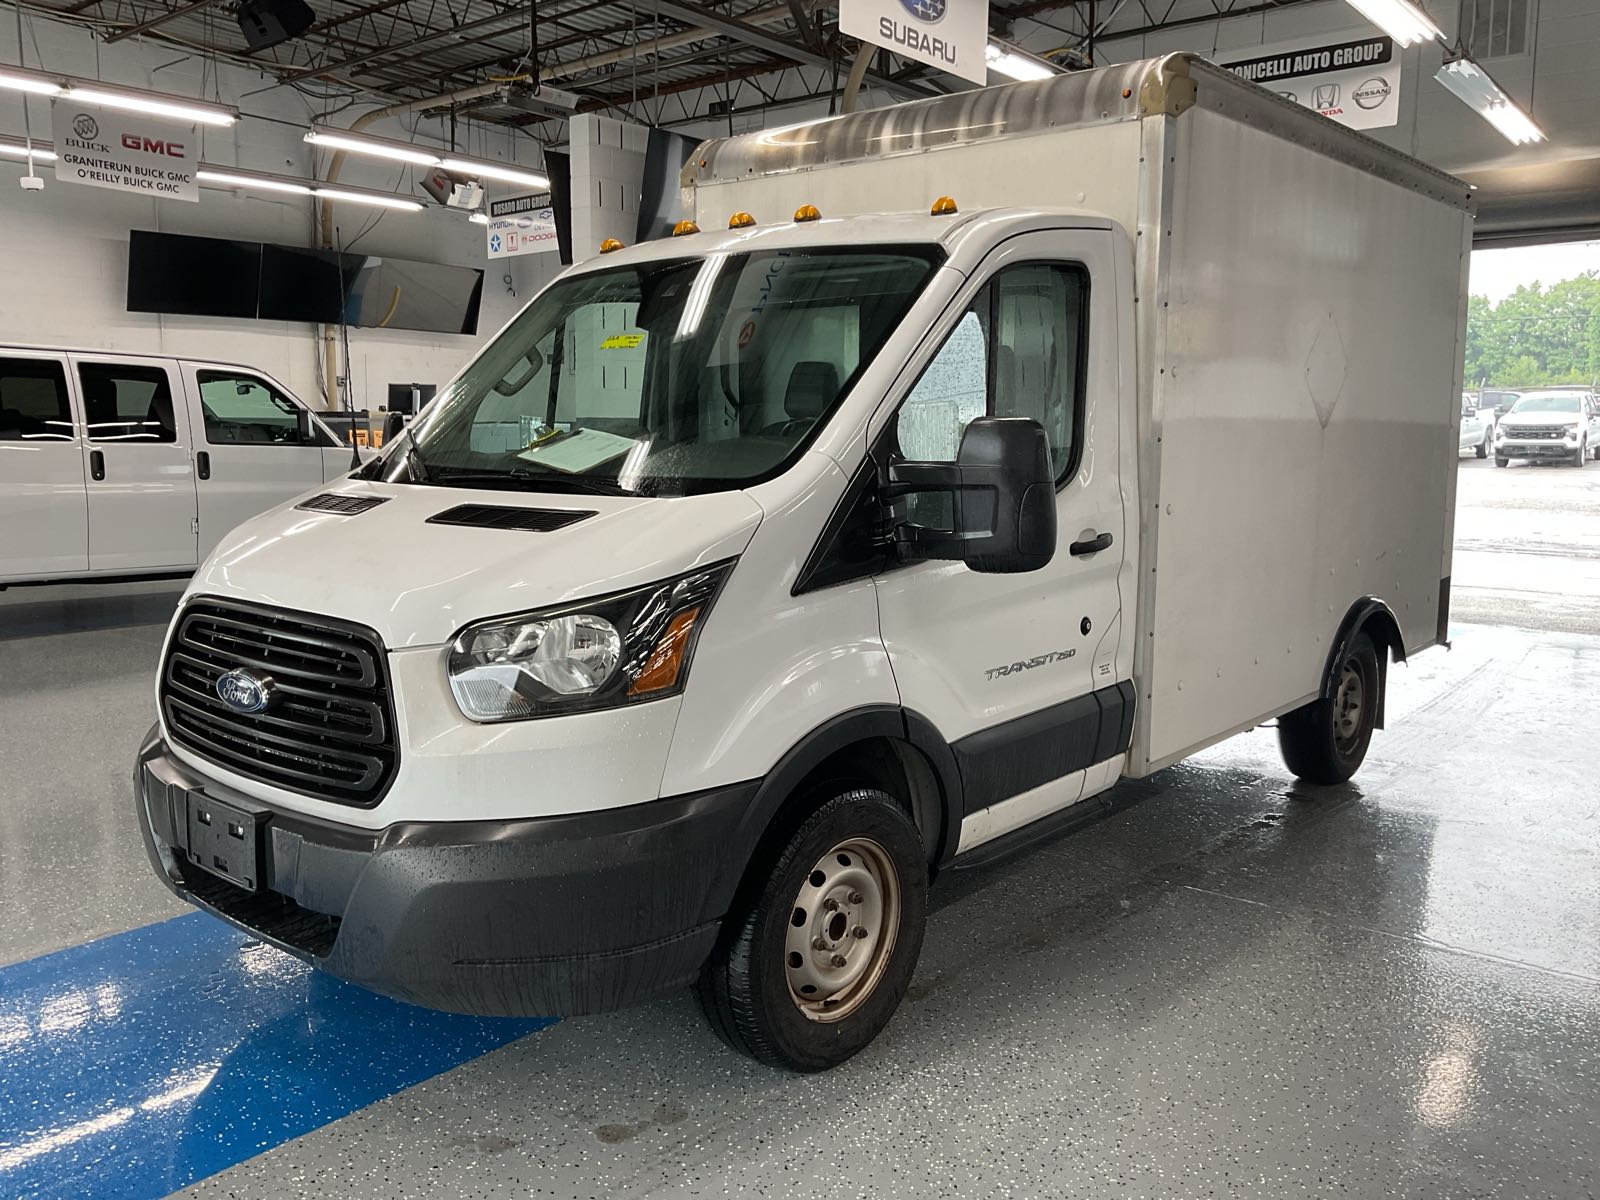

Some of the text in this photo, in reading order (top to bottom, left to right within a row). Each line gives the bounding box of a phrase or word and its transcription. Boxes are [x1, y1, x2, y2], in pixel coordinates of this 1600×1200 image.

[879, 17, 956, 64] SUBARU
[1293, 51, 1331, 72] AUTO
[1333, 43, 1383, 66] GROUP
[1355, 88, 1388, 98] NISSAN
[65, 137, 111, 153] BUICK
[121, 133, 185, 158] GMC
[64, 153, 190, 184] GRANITERUN BUICK GMC
[77, 168, 180, 194] O'REILLY BUICK GMC
[516, 198, 530, 212] AUTO
[984, 648, 1077, 681] TRANSIT 250
[222, 678, 254, 705] Ford
